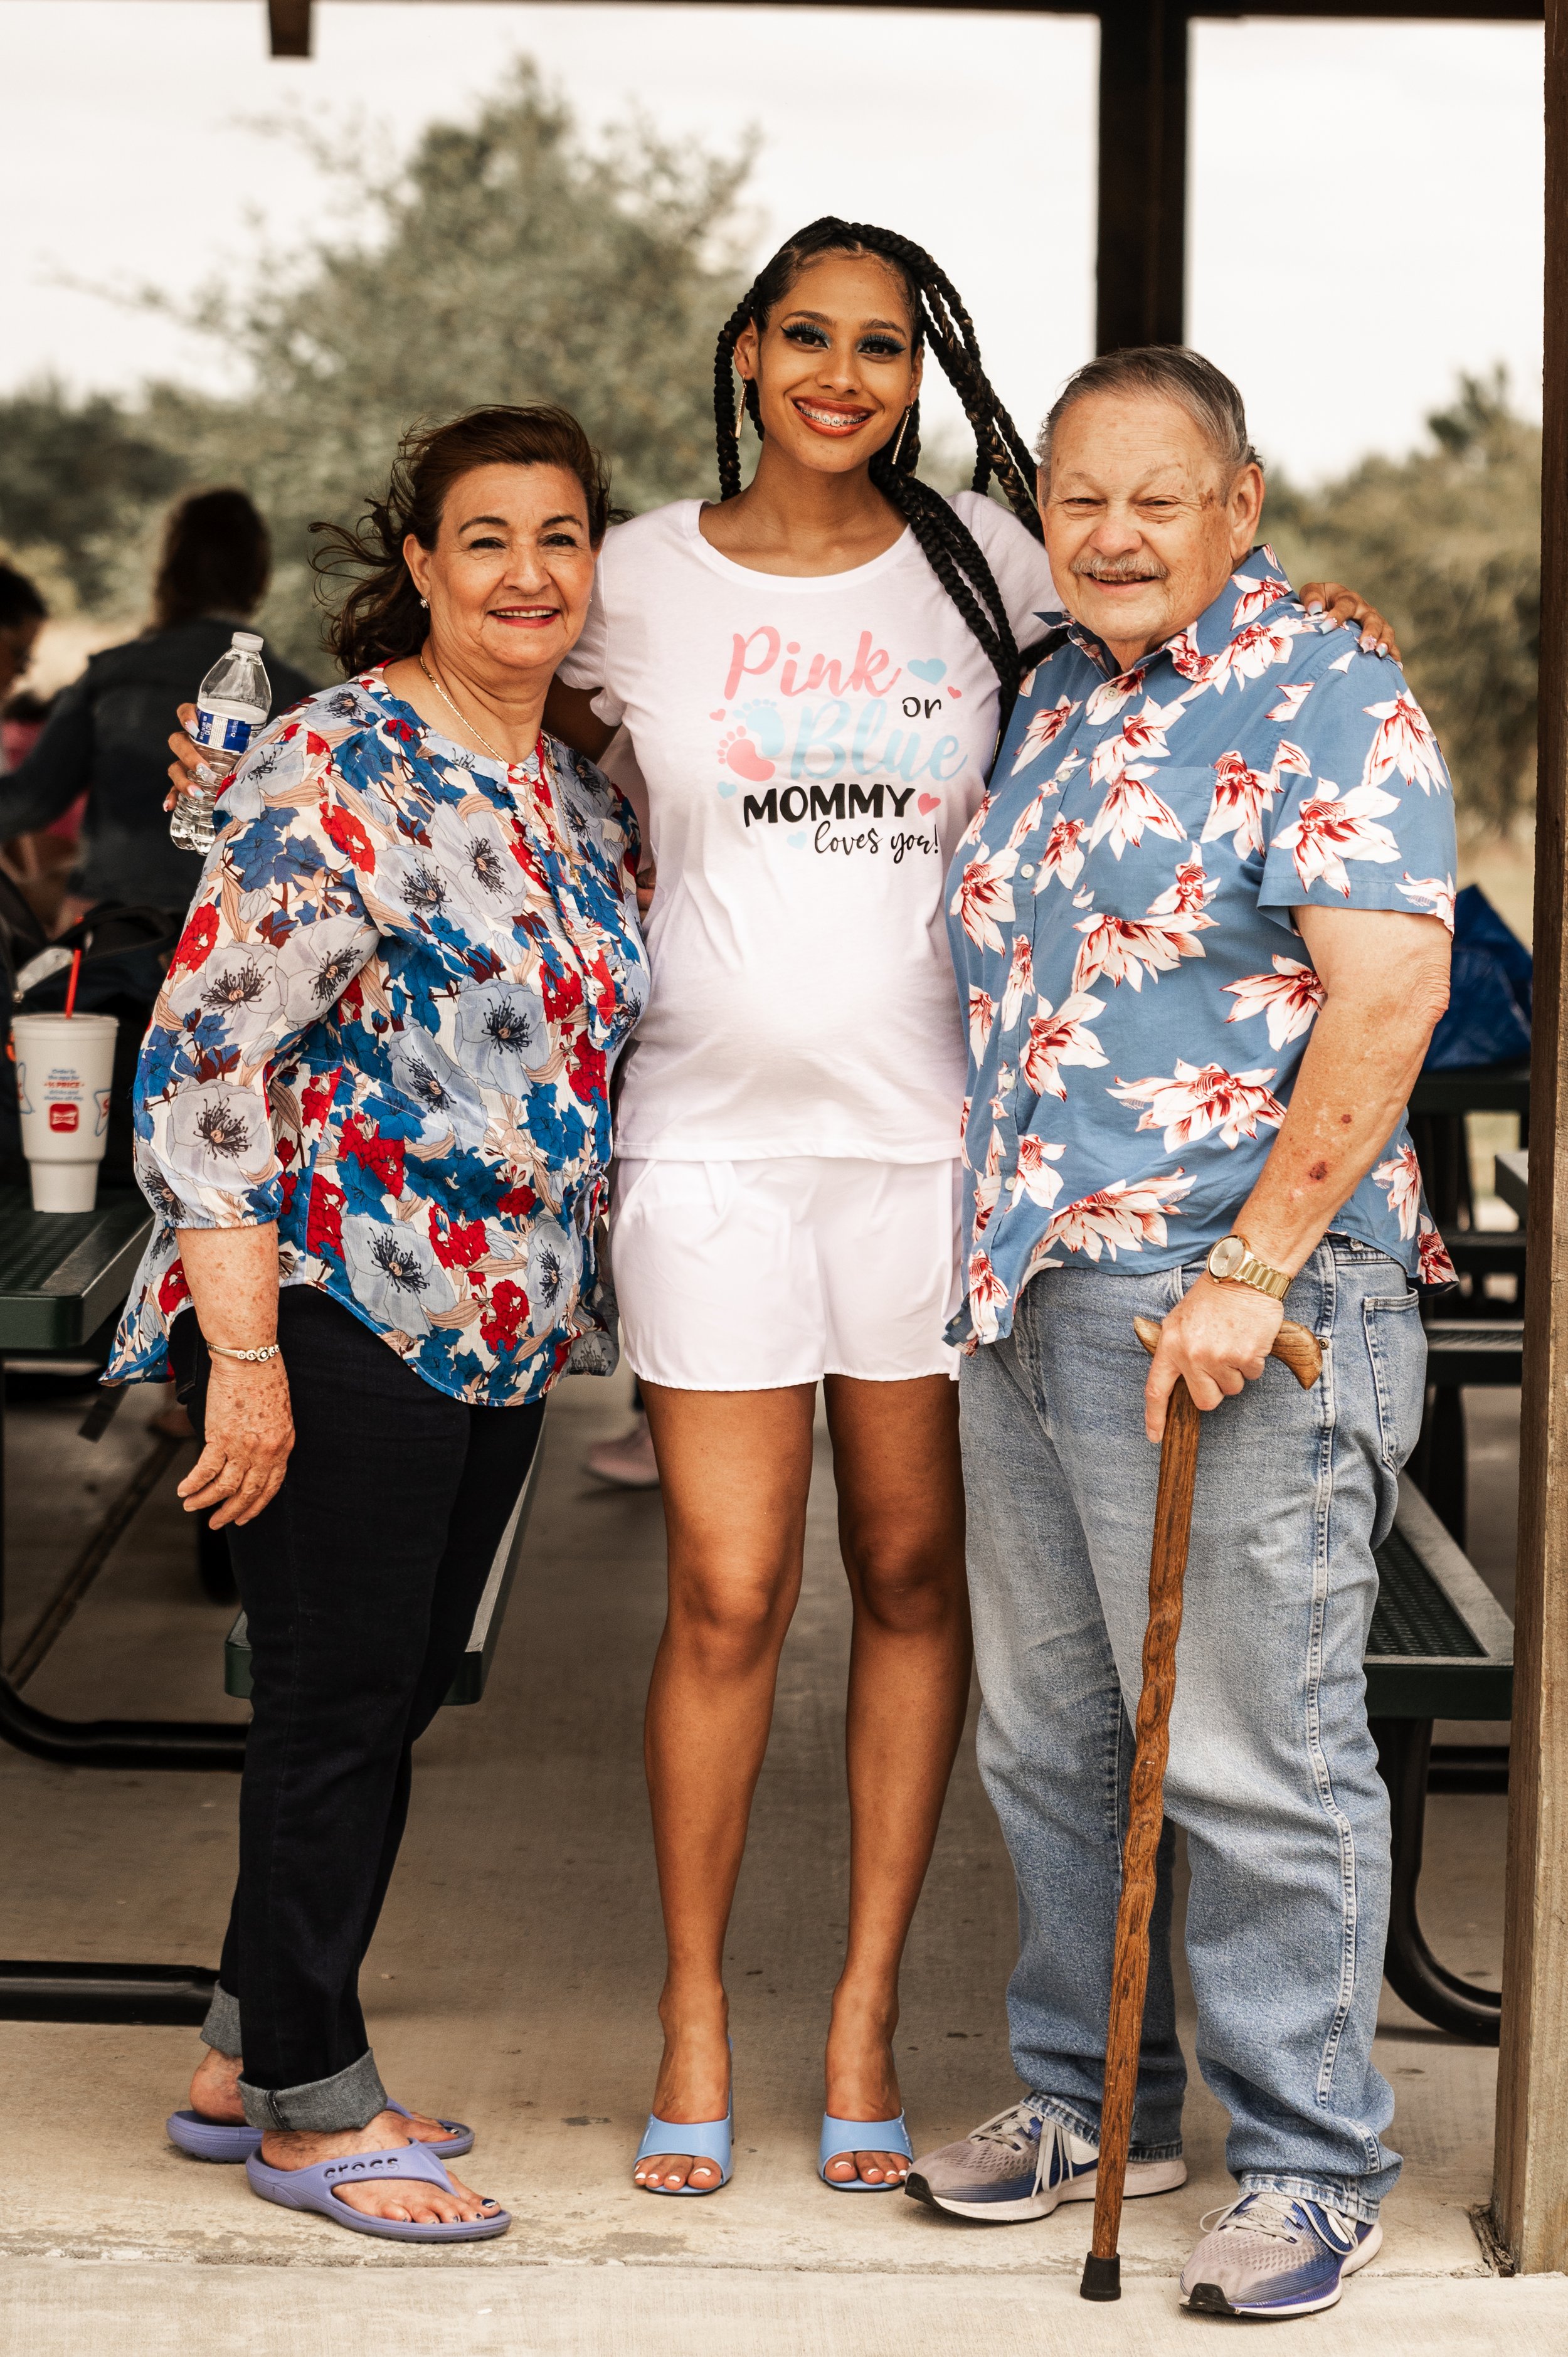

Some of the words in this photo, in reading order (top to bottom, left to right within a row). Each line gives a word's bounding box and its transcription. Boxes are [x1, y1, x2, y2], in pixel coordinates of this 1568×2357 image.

[724, 625, 901, 700] Pink
[902, 696, 941, 719] or
[790, 698, 968, 783] Blue
[743, 783, 916, 827] MOMMY
[814, 820, 883, 855] loves
[891, 824, 938, 864] you!
[323, 2157, 400, 2183] crocs
